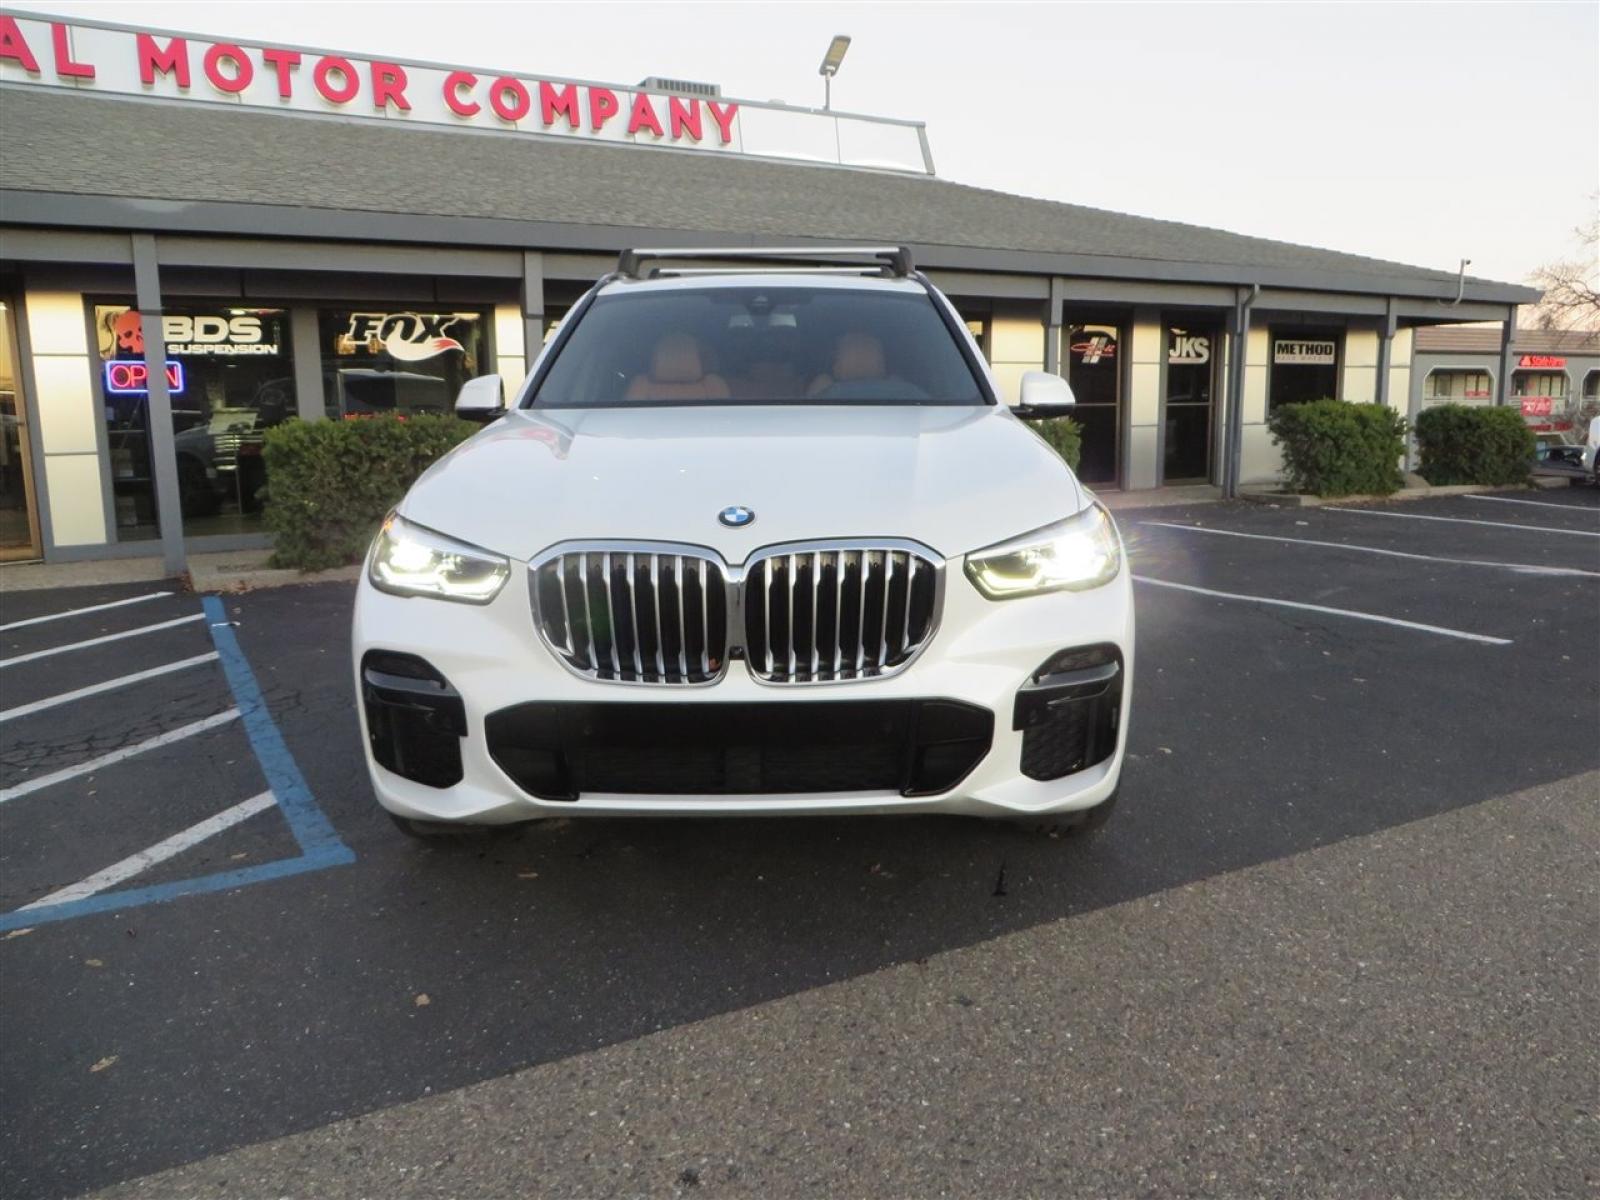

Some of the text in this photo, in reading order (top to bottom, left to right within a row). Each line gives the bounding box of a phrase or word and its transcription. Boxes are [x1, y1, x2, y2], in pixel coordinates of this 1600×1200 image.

[135, 31, 412, 111] MOTOR
[442, 70, 739, 143] COMPANY
[161, 316, 263, 343] BDS
[345, 313, 464, 350] FOX
[167, 343, 278, 355] SUSPENSION
[1168, 336, 1210, 364] JKS
[1276, 343, 1333, 356] METHOD
[110, 364, 179, 388] OPN
